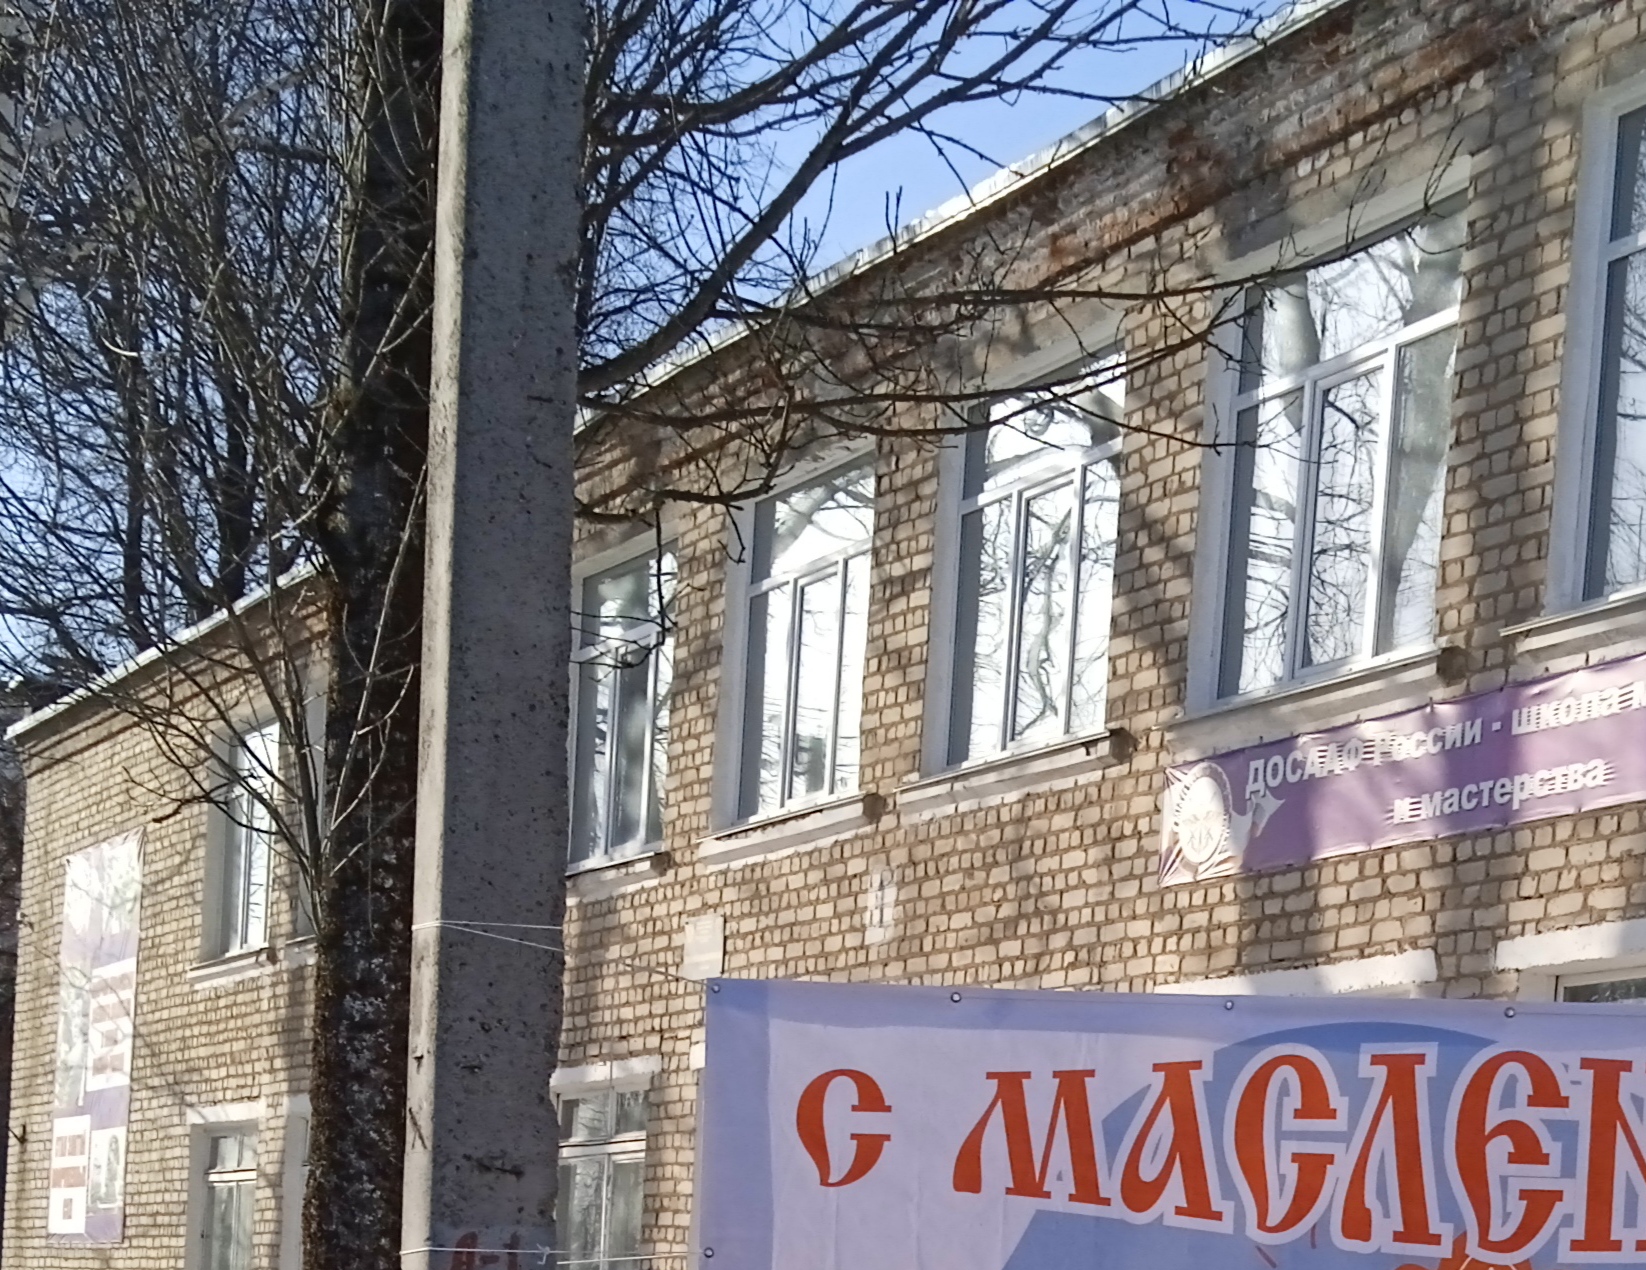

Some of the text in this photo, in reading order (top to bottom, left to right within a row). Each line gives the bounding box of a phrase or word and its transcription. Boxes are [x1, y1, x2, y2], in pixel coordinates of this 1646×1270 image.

[1244, 737, 1365, 799] ДОСААФ
[1373, 716, 1483, 767] России
[1511, 686, 1621, 736] школа
[1421, 758, 1607, 820] мастерства
